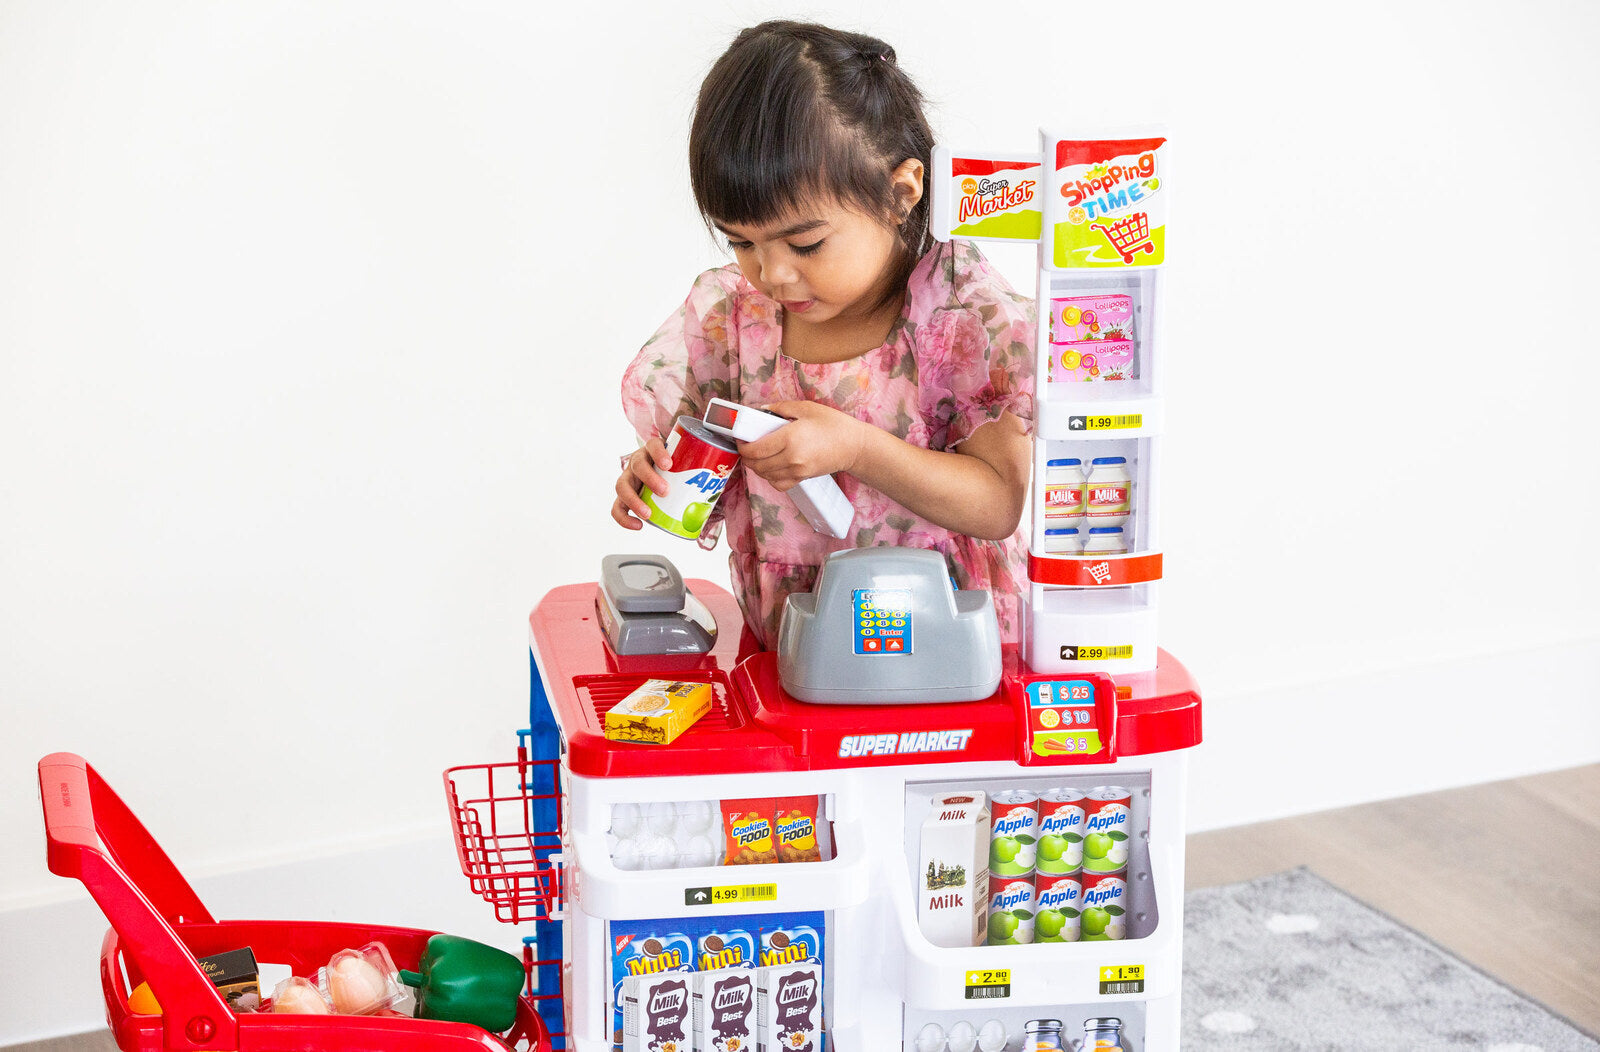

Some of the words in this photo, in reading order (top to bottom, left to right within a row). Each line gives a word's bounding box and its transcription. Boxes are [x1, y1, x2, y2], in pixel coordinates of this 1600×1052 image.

[977, 179, 1009, 195] Super
[1060, 153, 1155, 207] Shopping
[959, 180, 1036, 222] Market
[1082, 183, 1144, 219] TIME
[1095, 300, 1129, 310] Lollipops
[1095, 344, 1130, 353] Lollipops
[1088, 417, 1111, 428] 1.99
[684, 471, 728, 494] App
[1050, 490, 1075, 502] Milk
[1095, 489, 1119, 501] Milk
[1079, 648, 1103, 658] 2.99
[1072, 686, 1089, 699] 25
[1074, 710, 1090, 723] 10
[839, 734, 899, 757] SUPER
[898, 730, 973, 754] MARKET
[1078, 738, 1087, 750] 5
[939, 810, 966, 820] Milk
[1041, 814, 1080, 832] Apple
[1087, 812, 1126, 830] Apple
[733, 820, 768, 836] Cookies
[776, 819, 810, 834] Cookies
[995, 816, 1033, 834] Apple
[740, 828, 770, 845] FOOD
[782, 826, 812, 843] FOOD
[714, 890, 738, 900] 4.99
[929, 893, 963, 910] Milk
[992, 890, 1031, 909] Apple
[1039, 888, 1077, 906] Apple
[1084, 886, 1122, 904] Apple
[616, 935, 629, 952] NEW
[628, 950, 680, 976] Mini
[698, 946, 742, 971] Mini
[760, 943, 807, 967] Mini
[208, 969, 225, 977] round
[718, 991, 745, 1007] Milk
[783, 985, 809, 1001] Milk
[653, 995, 680, 1011] Milk
[721, 1010, 744, 1023] Best
[786, 1005, 808, 1018] Best
[656, 1014, 679, 1027] Best
